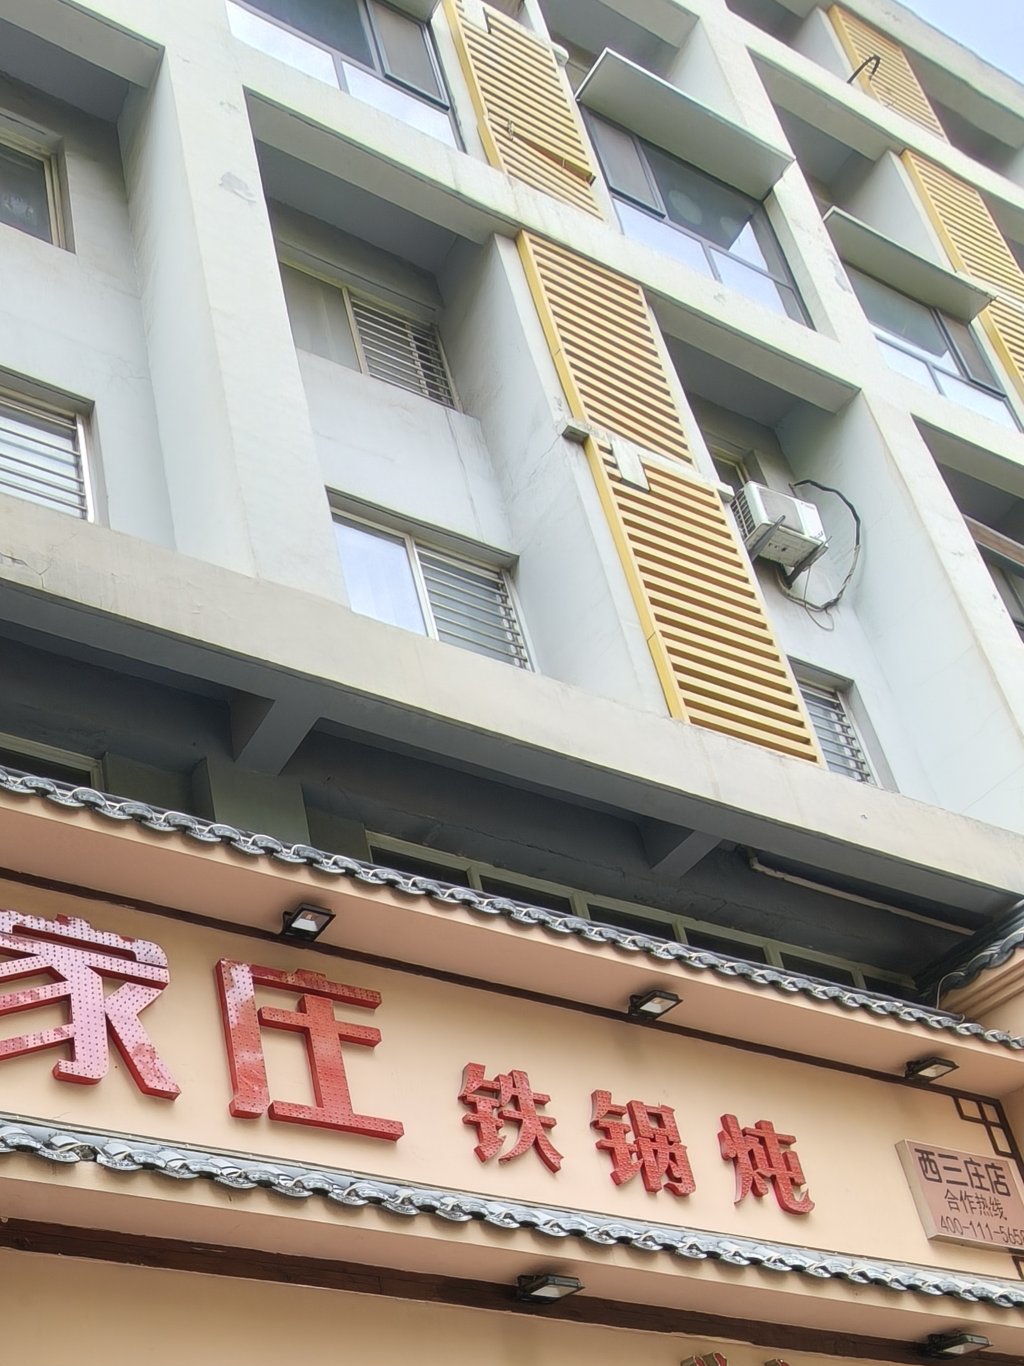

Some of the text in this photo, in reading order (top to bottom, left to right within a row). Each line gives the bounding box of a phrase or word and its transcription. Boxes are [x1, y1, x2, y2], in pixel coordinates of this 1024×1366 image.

[459, 1062, 815, 1216] 铁锅炖
[914, 1147, 1011, 1197] 西三庄店
[943, 1188, 1008, 1221] 合作热线
